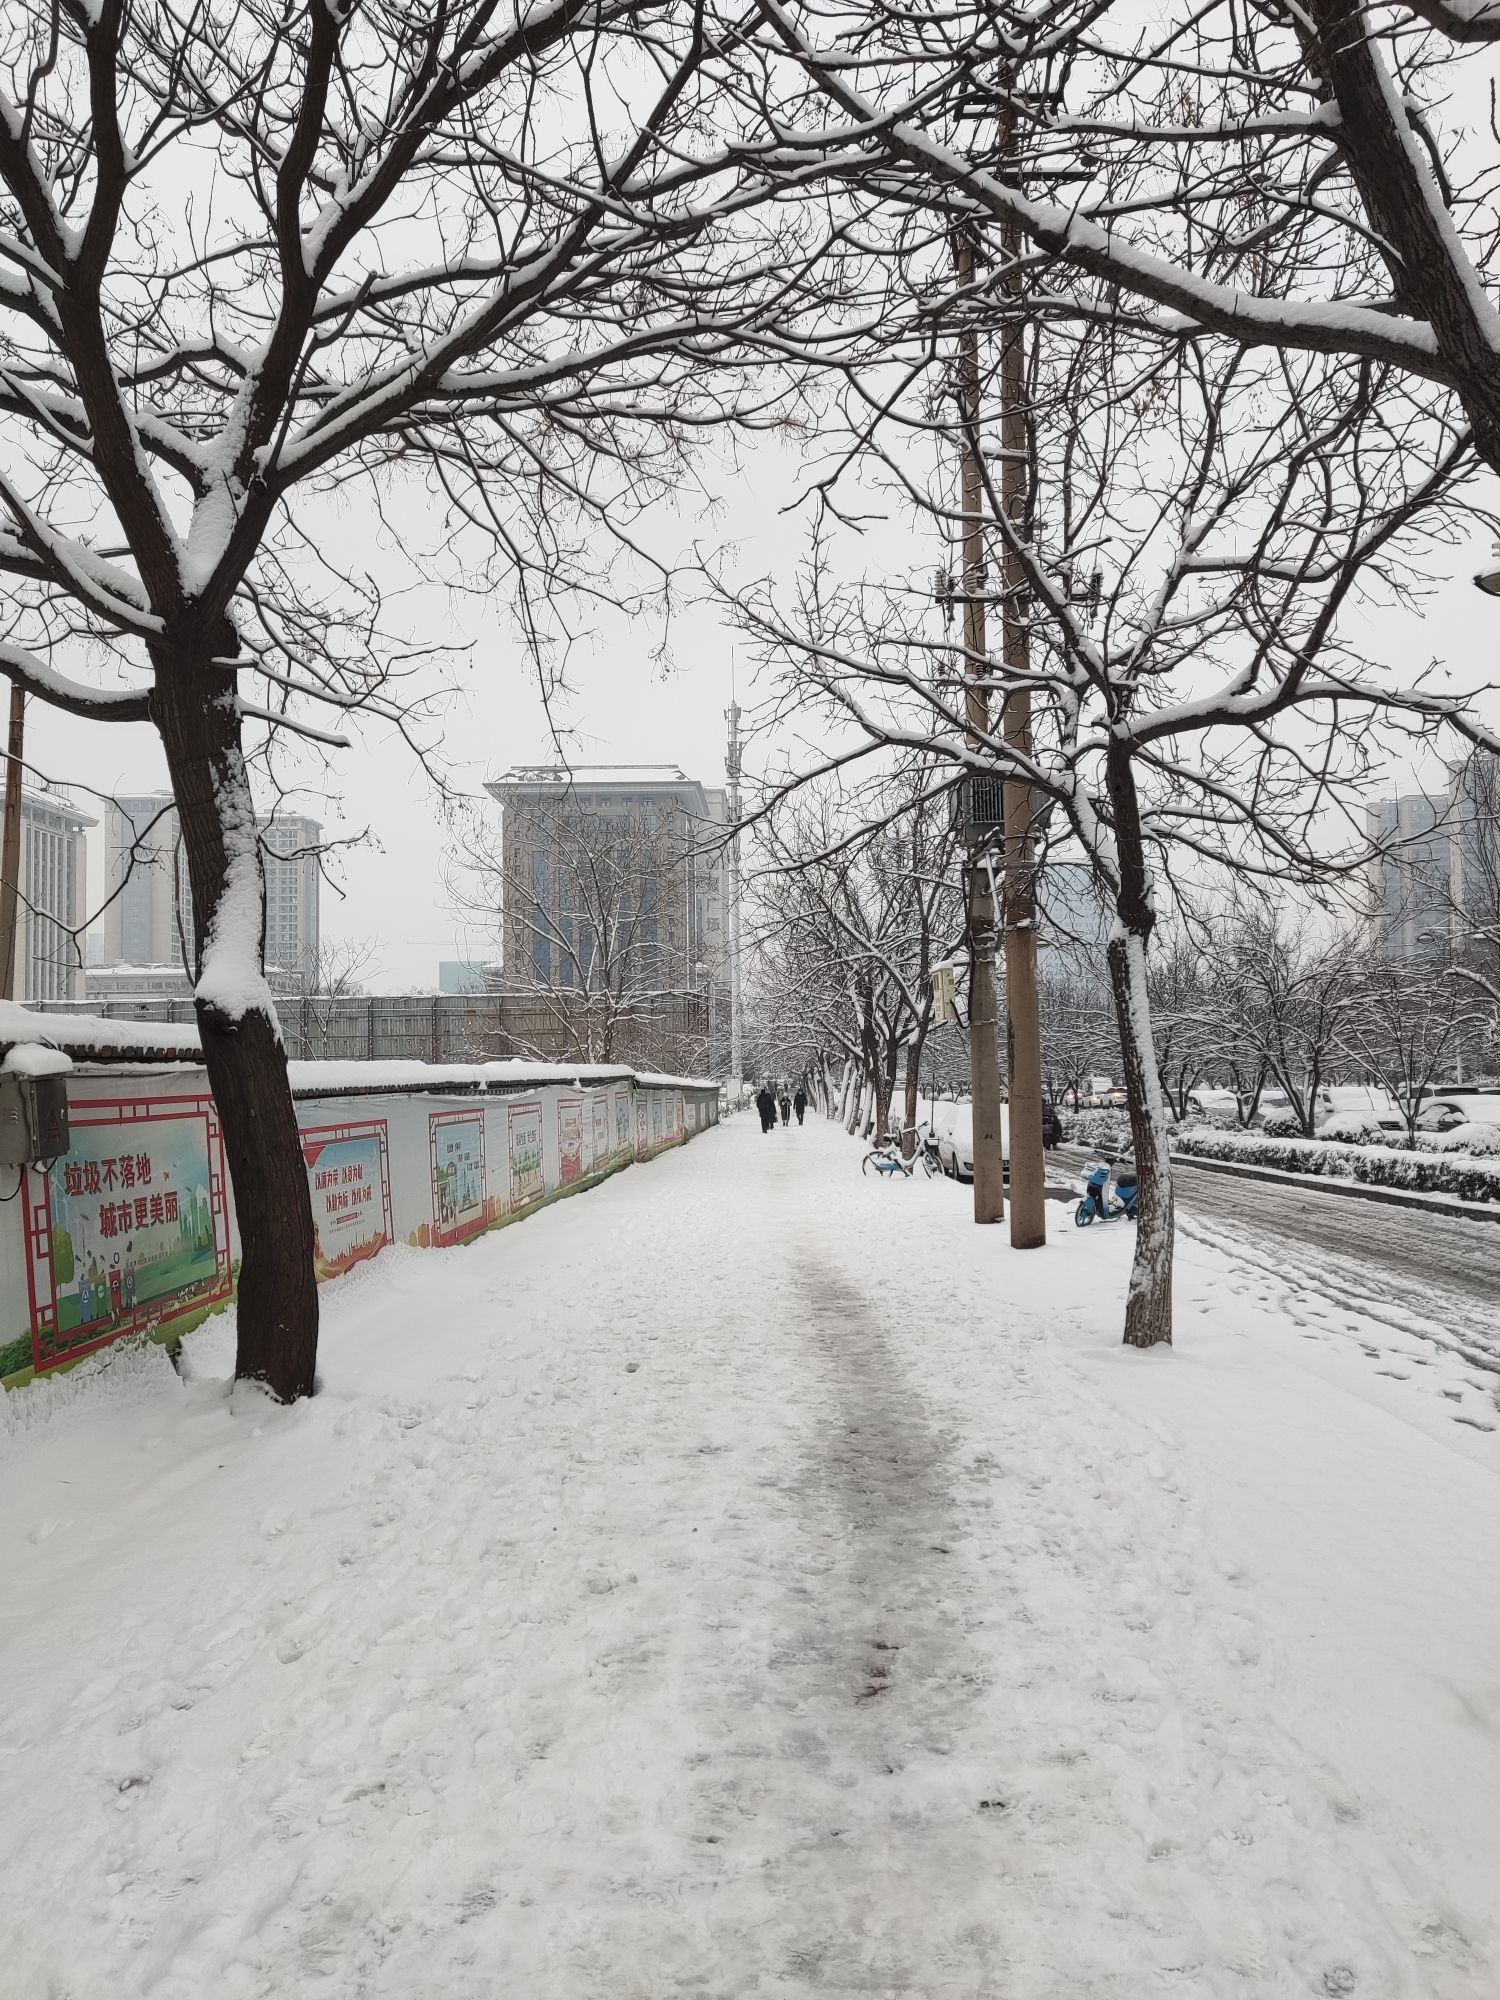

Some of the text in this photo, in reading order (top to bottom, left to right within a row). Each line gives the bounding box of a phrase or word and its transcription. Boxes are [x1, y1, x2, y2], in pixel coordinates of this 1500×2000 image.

[64, 1152, 152, 1197] 垃圾不落地
[99, 1191, 178, 1238] 城市更美丽
